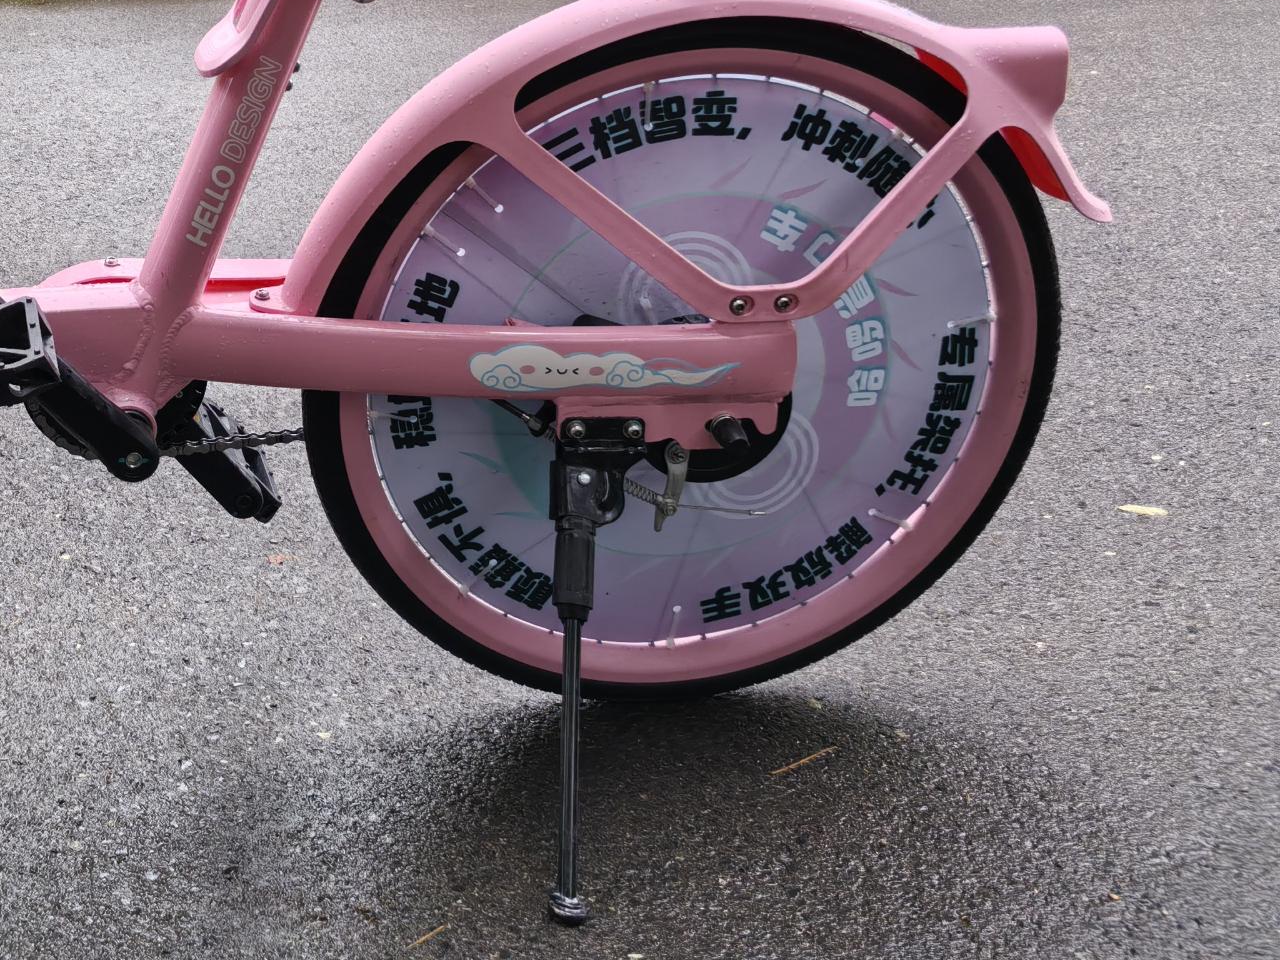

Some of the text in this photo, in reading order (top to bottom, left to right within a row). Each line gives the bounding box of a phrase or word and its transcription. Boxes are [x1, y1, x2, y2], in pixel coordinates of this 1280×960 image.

[185, 56, 284, 248] HELLO DESIGN
[781, 103, 939, 230] 冲刺随
[699, 516, 873, 623] 解放双手
